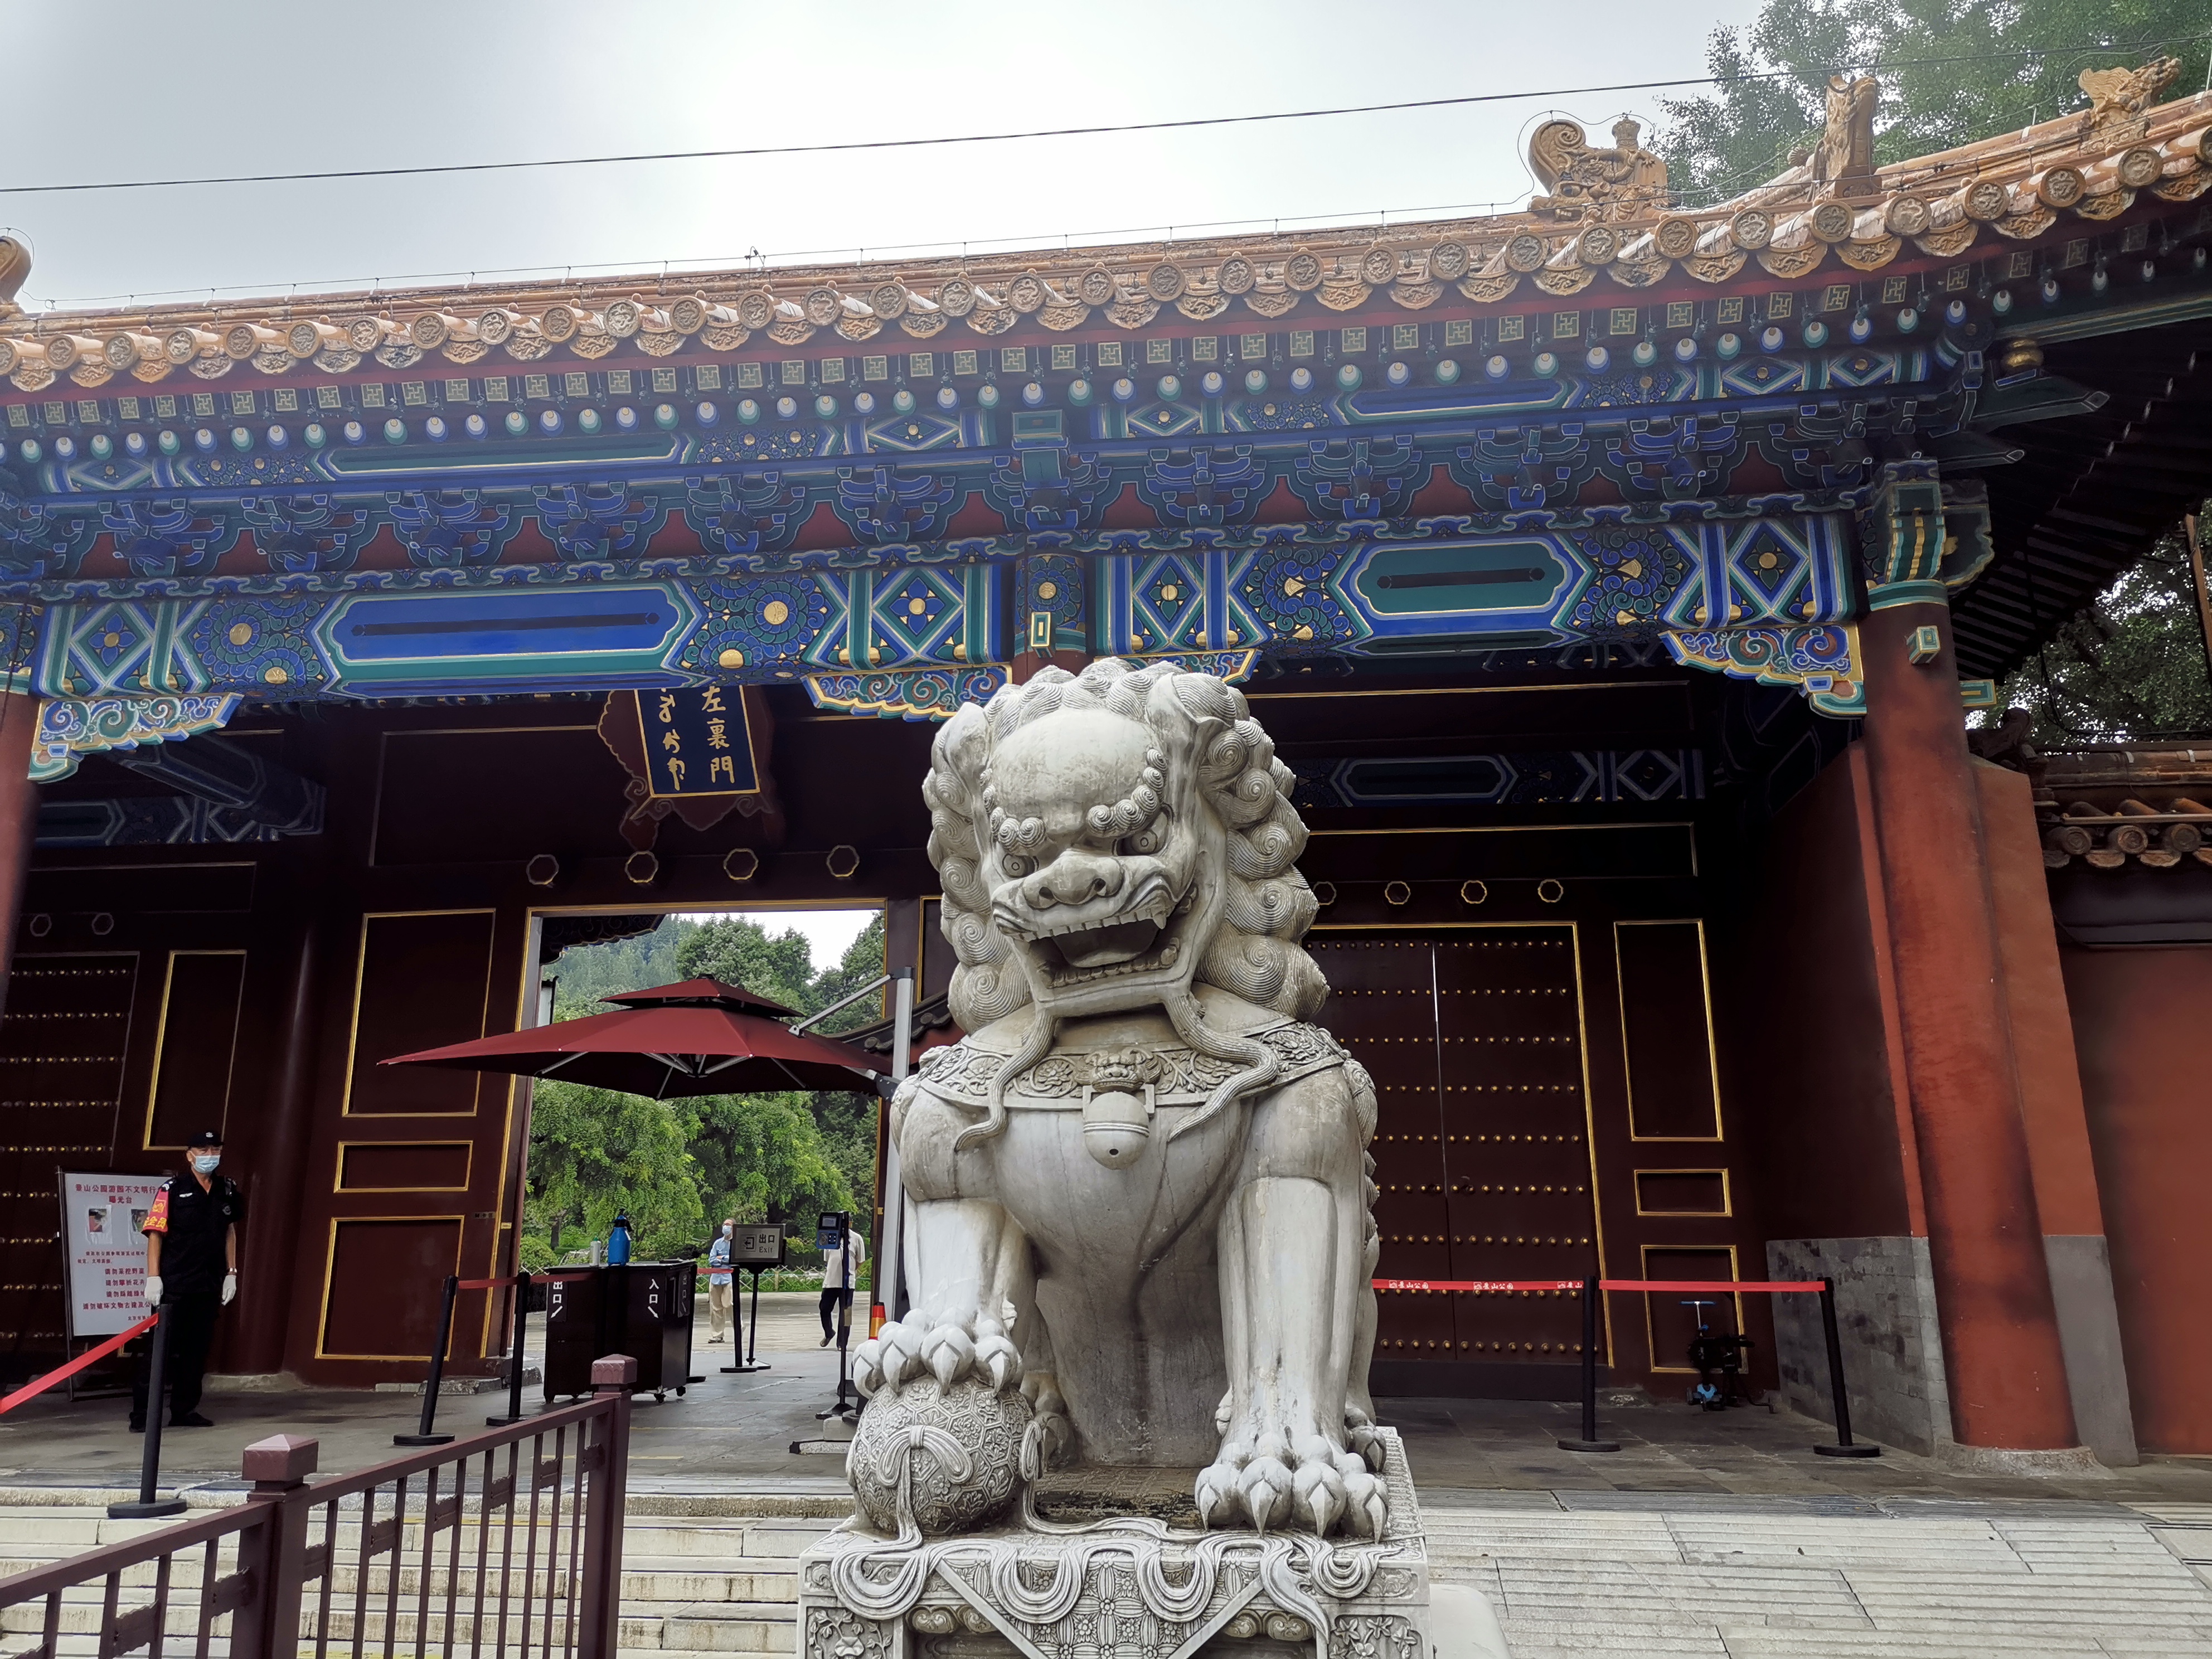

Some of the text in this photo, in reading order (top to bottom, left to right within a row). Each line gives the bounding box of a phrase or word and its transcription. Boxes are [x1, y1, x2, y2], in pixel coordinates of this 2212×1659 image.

[701, 686, 735, 783] 左裏門
[76, 1184, 158, 1194] 景山公园游园不文明行
[759, 1234, 775, 1243] 出口
[1398, 1281, 1429, 1289] 景山公园
[1482, 1282, 1514, 1290] 景山公园
[552, 1281, 563, 1303] 出口
[649, 1278, 659, 1304] 入口
